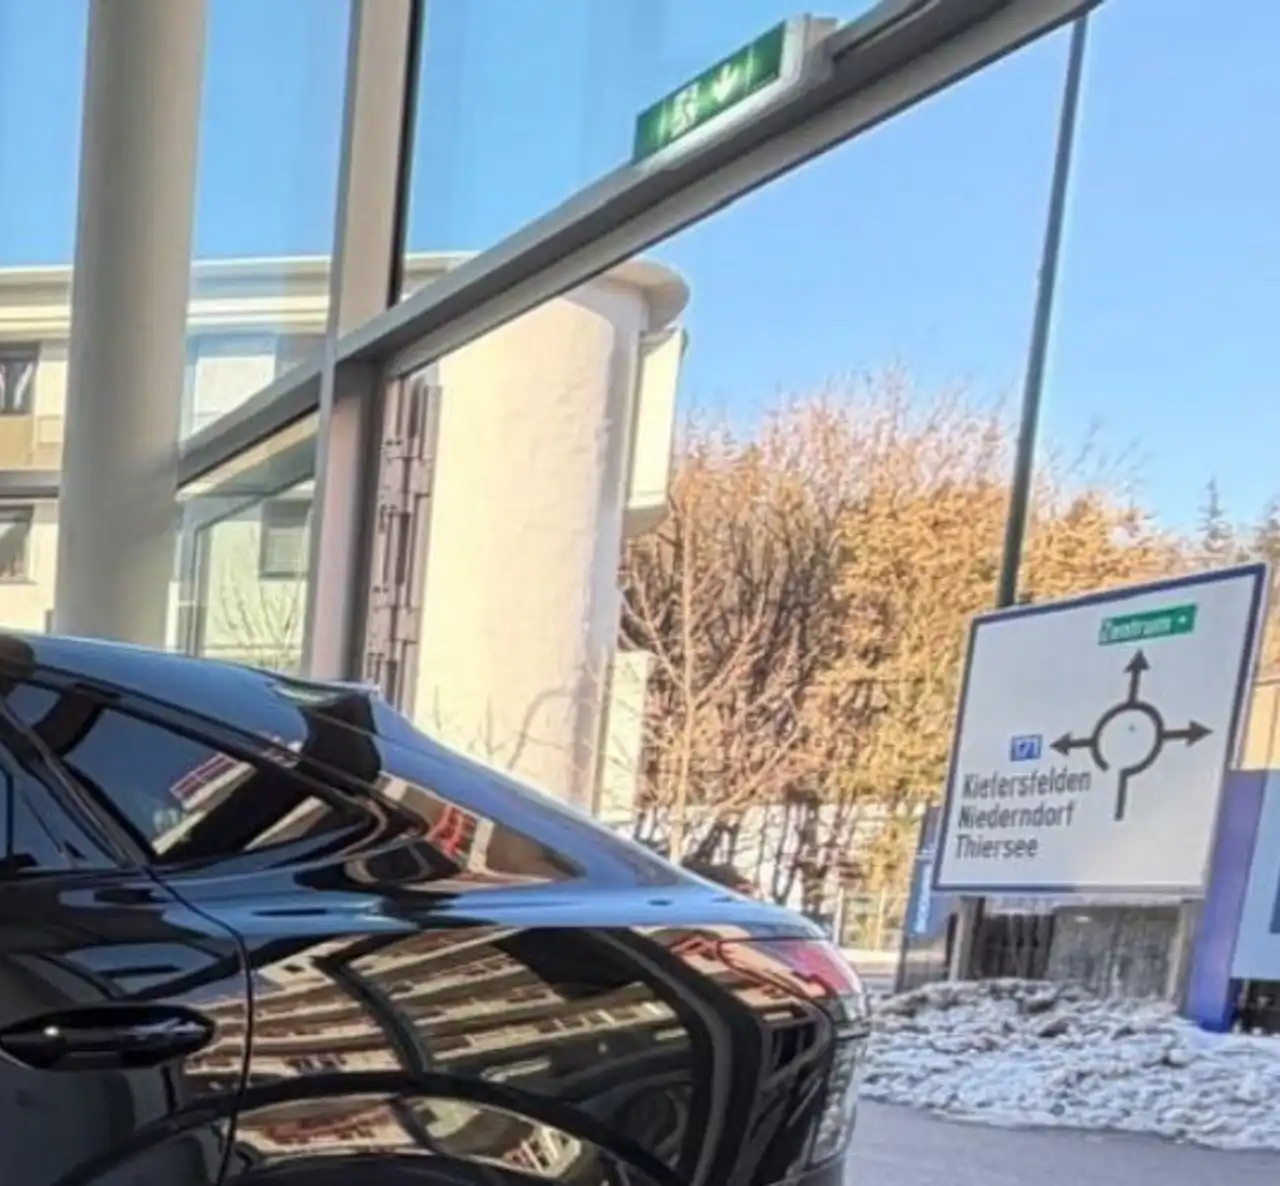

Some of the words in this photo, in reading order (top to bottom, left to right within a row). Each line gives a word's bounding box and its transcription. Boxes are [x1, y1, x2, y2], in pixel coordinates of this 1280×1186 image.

[962, 763, 1093, 800] Kiefersfelden
[958, 799, 1075, 830] Niederndorf
[955, 833, 1040, 860] Thiersee
